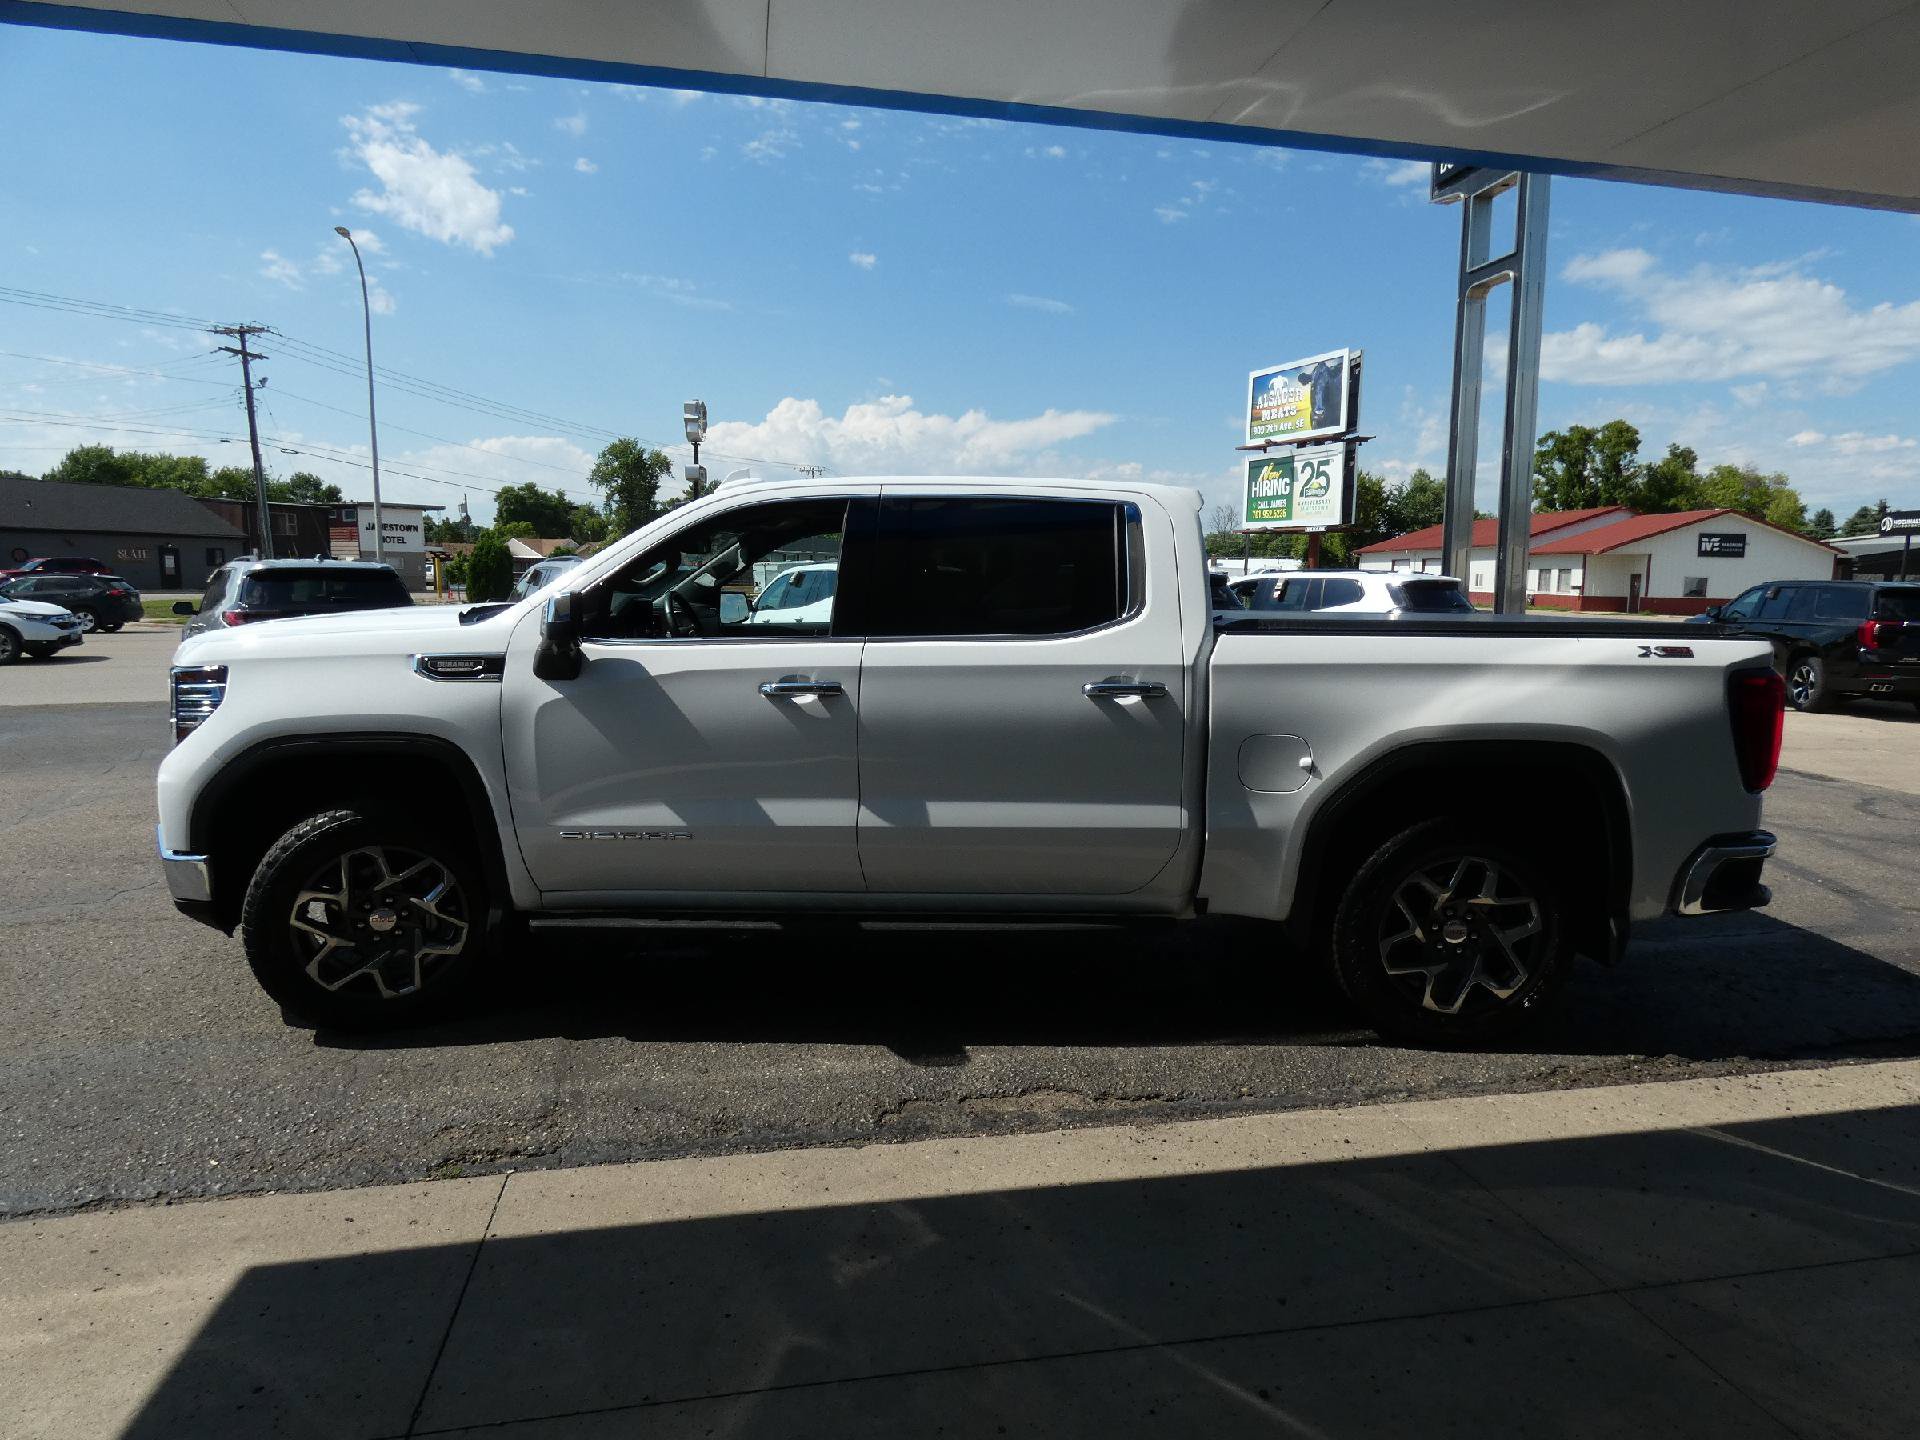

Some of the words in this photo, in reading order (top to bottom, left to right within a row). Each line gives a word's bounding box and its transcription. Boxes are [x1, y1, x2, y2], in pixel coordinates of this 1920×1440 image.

[1261, 405, 1297, 421] MEATS
[1251, 478, 1291, 498] HIRING
[365, 522, 419, 533] JAESTOWN
